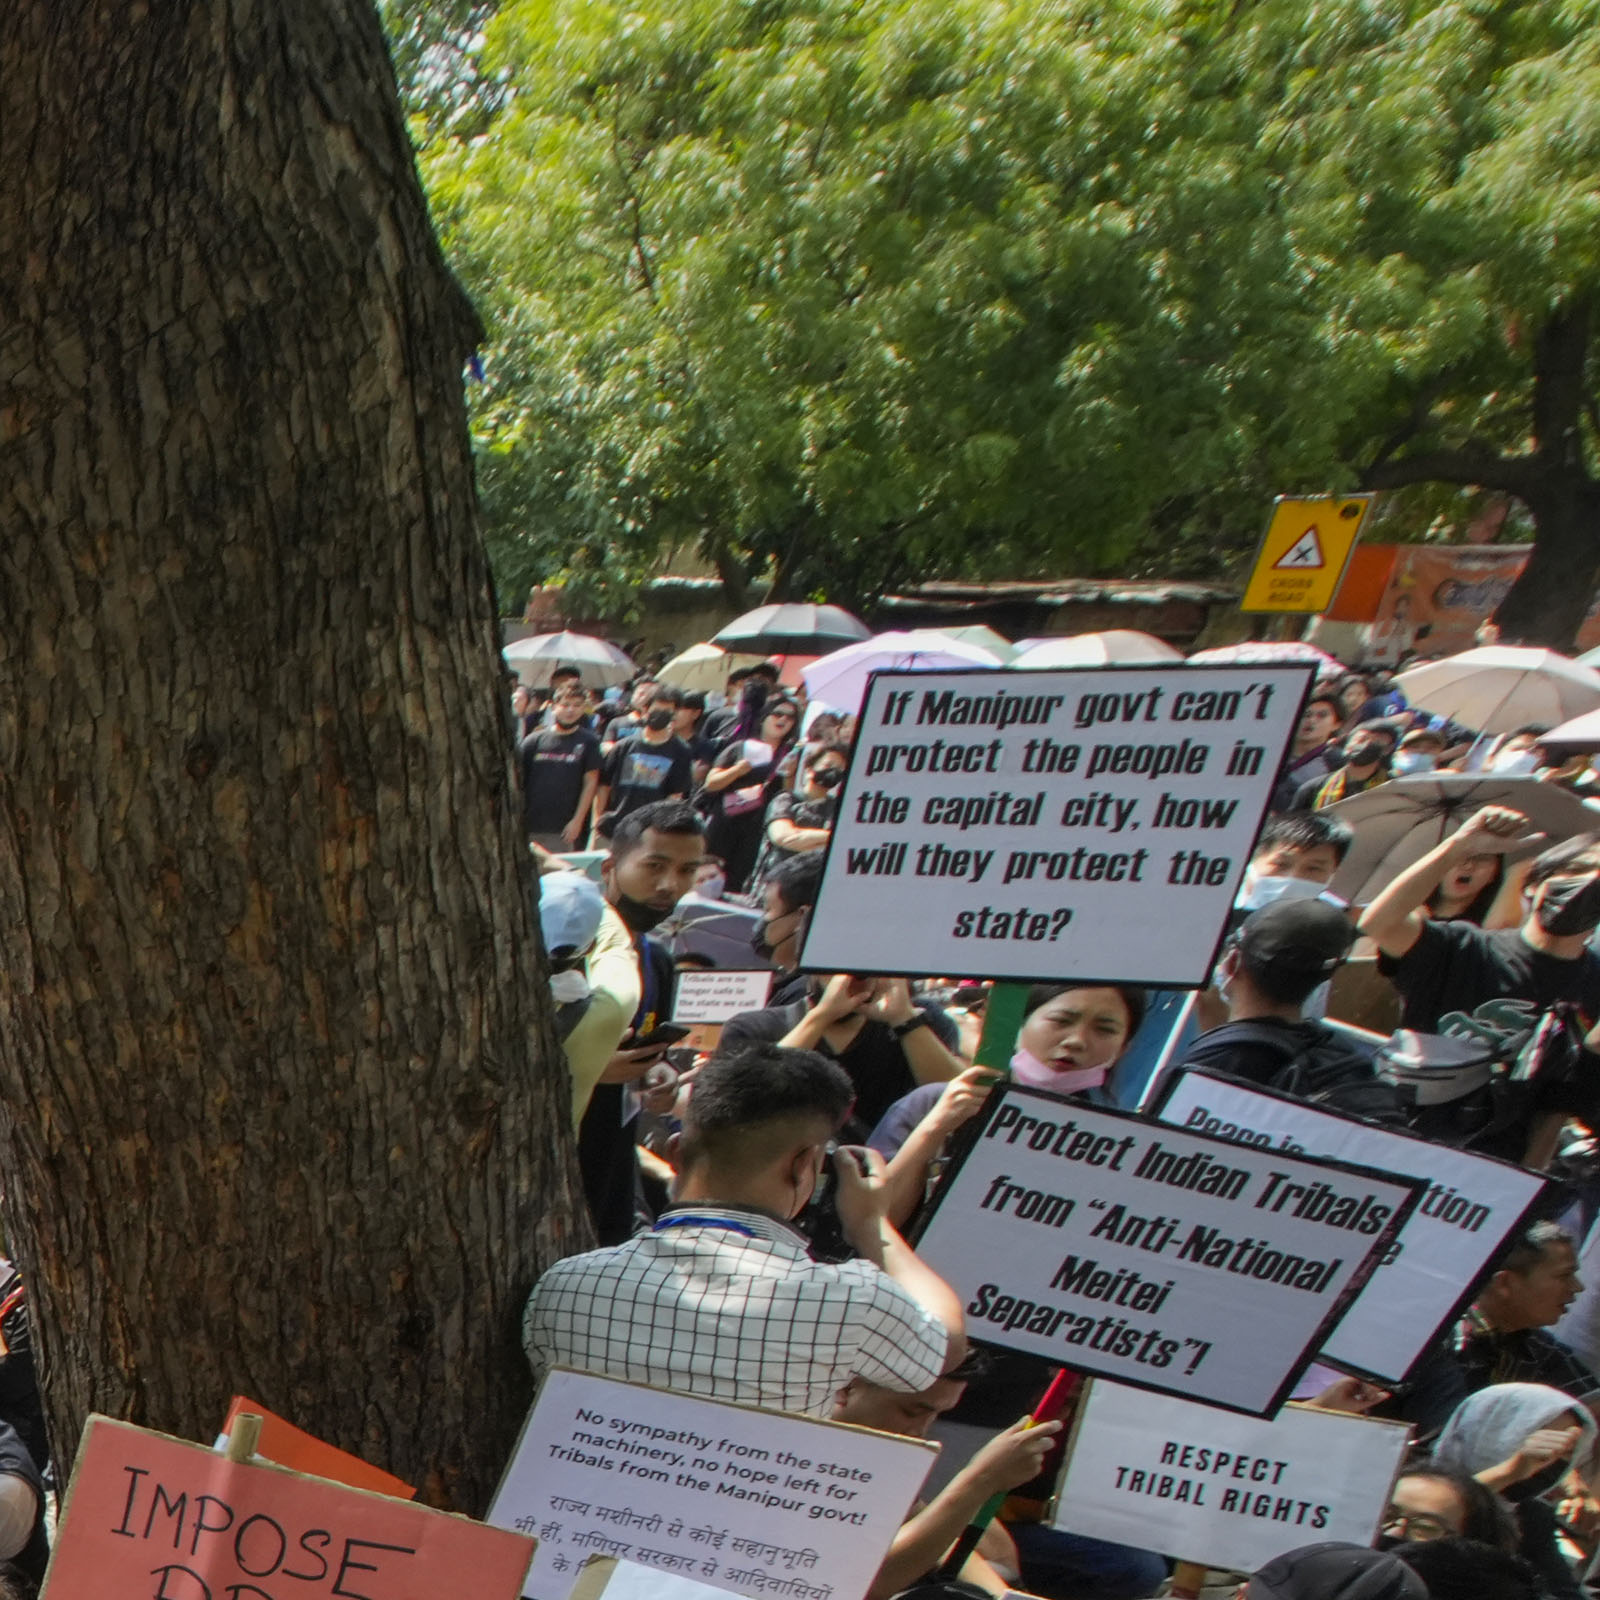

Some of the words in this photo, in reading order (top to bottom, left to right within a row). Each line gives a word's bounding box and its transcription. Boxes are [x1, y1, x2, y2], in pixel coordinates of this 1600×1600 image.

[881, 690, 914, 725] If
[917, 690, 1064, 730] Manipur
[1074, 686, 1163, 728] govt
[1170, 684, 1274, 722] can't
[866, 738, 1002, 777] protect
[1022, 738, 1081, 773] the
[1084, 739, 1208, 779] people
[1225, 740, 1264, 777] in
[855, 791, 909, 824] the
[922, 792, 1046, 829] capital
[1061, 794, 1139, 832] city,
[1152, 793, 1240, 828] how
[846, 843, 908, 875] will
[915, 844, 994, 883] they
[1003, 848, 1149, 884] protect
[1168, 851, 1230, 886] the
[953, 907, 1073, 941] state?
[986, 1104, 1135, 1172] Protect
[1135, 1141, 1250, 1201] Indian
[1253, 1172, 1391, 1235] Tribals
[981, 1176, 1075, 1228] from
[1088, 1199, 1343, 1295] "Anti-National
[1050, 1255, 1175, 1314] Meitei
[1161, 1442, 1288, 1486] RESPECT
[1114, 1467, 1206, 1507] TRIBAL
[1222, 1489, 1330, 1529] RIGHTS
